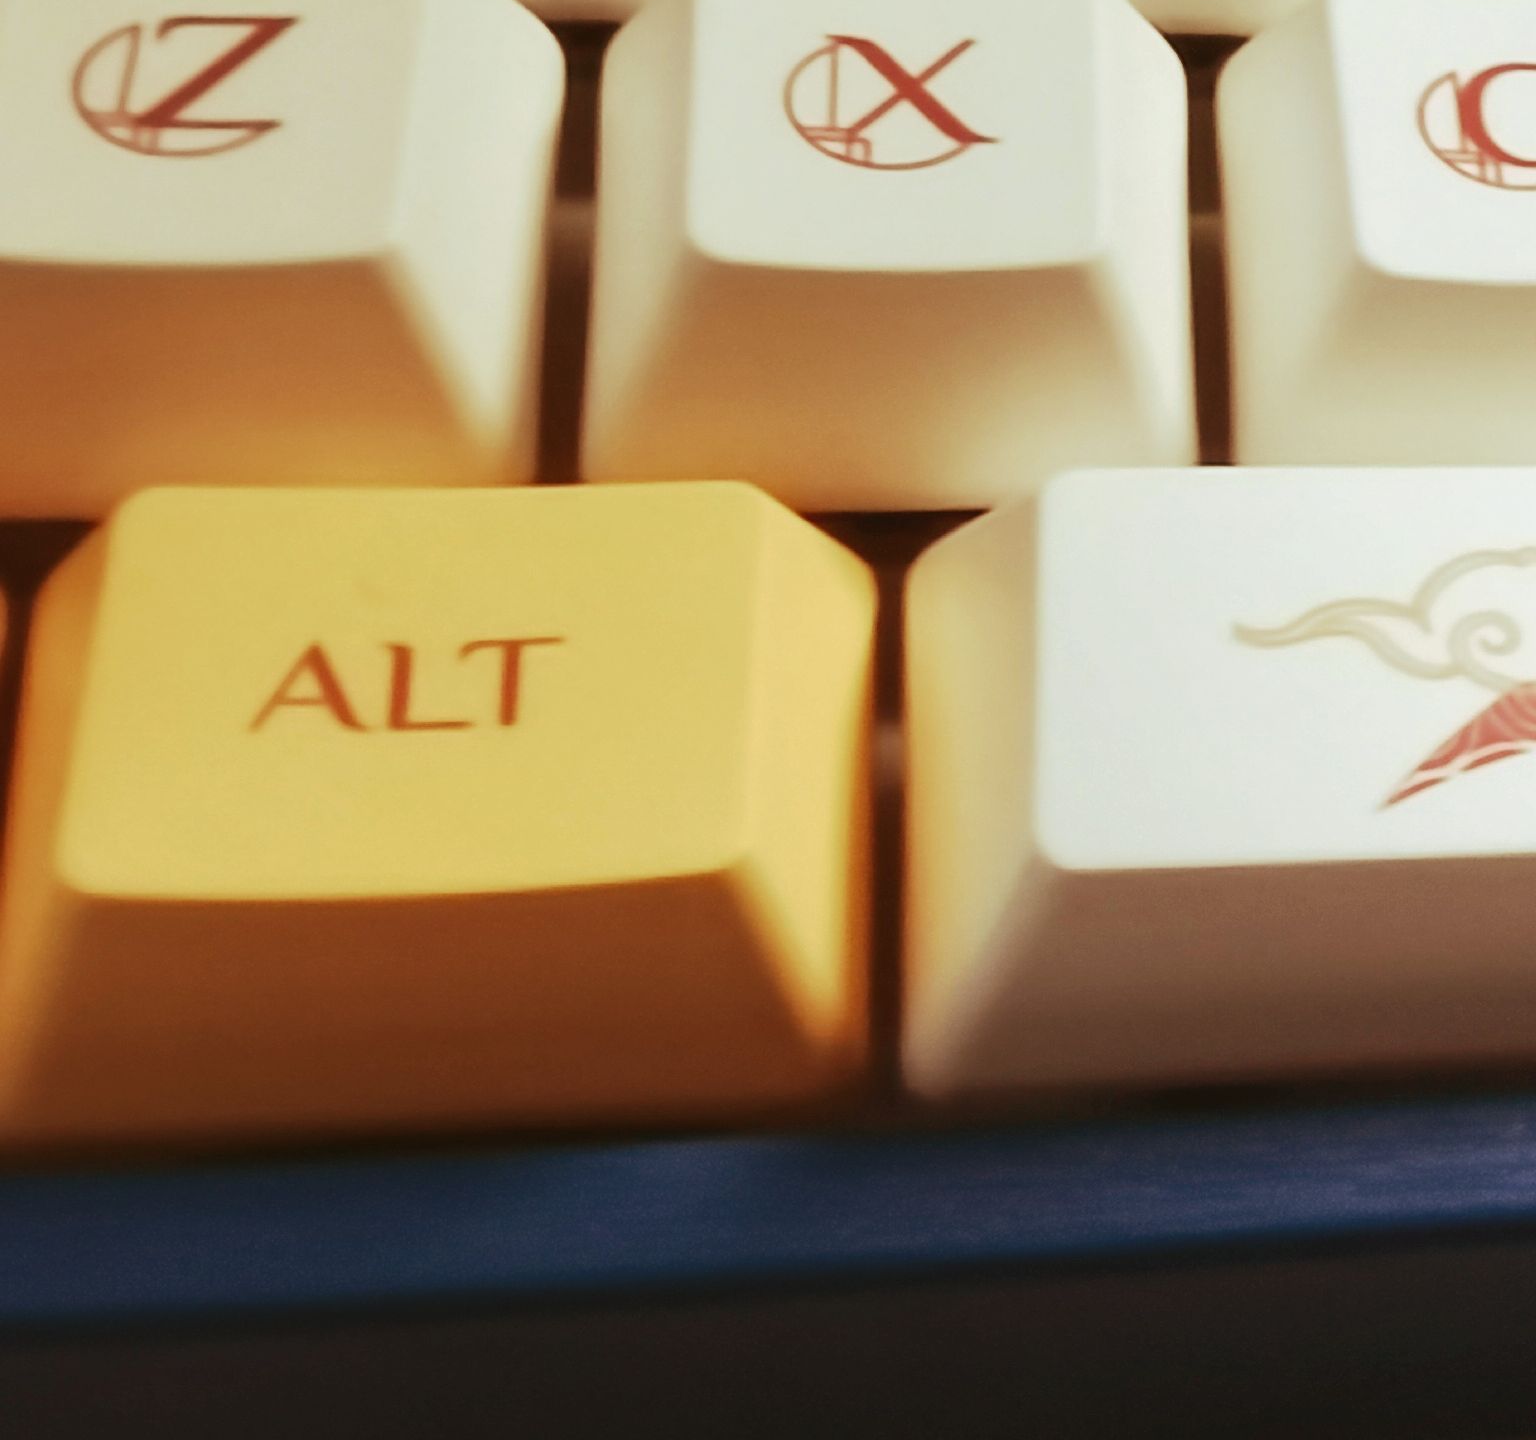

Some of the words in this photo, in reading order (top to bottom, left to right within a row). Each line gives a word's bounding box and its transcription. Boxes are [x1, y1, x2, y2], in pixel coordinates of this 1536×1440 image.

[131, 13, 302, 131] Z
[825, 31, 1003, 146] X
[246, 632, 568, 736] ALT
